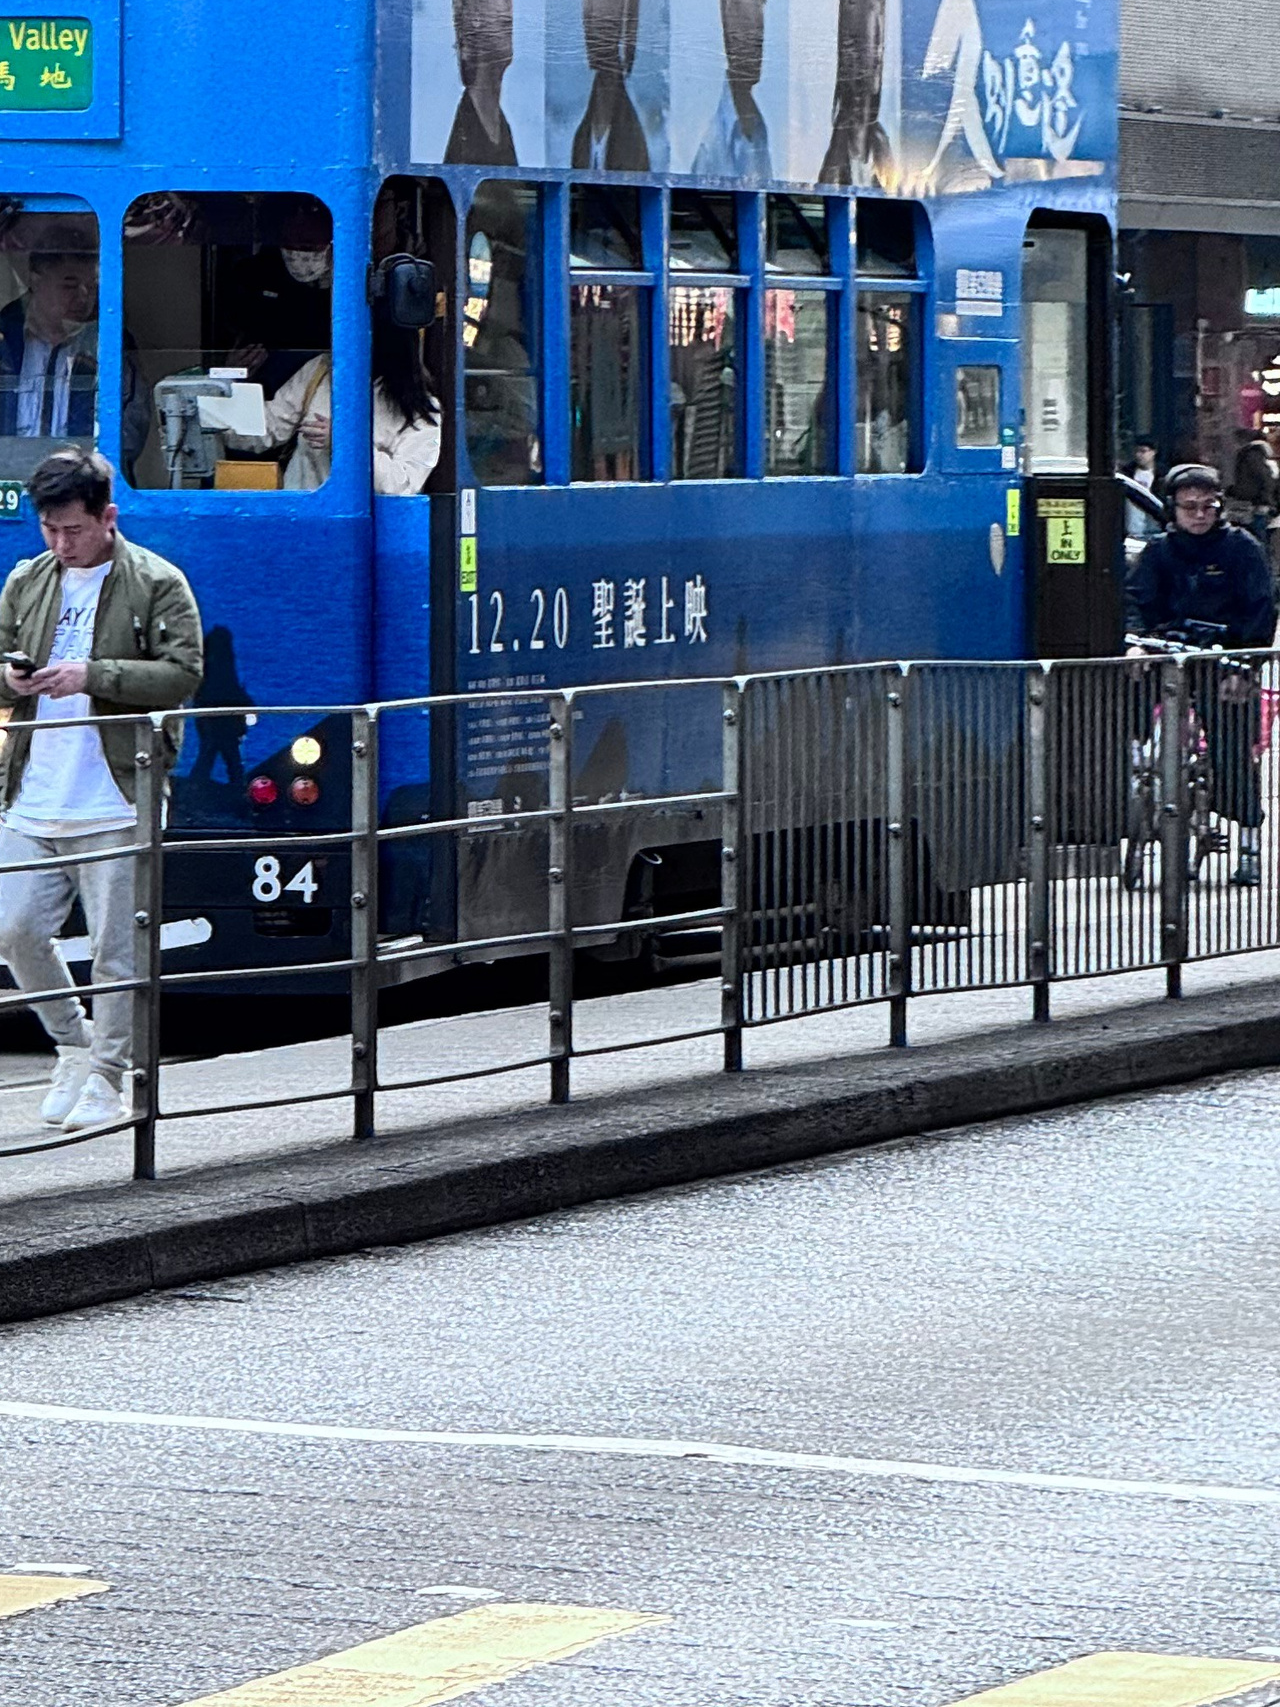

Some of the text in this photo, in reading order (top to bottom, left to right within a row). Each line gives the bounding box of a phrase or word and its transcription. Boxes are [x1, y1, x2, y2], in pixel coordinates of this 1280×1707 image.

[8, 21, 89, 57] Valley
[468, 574, 708, 655] 12.20 聖誕上映
[252, 856, 319, 904] 84
